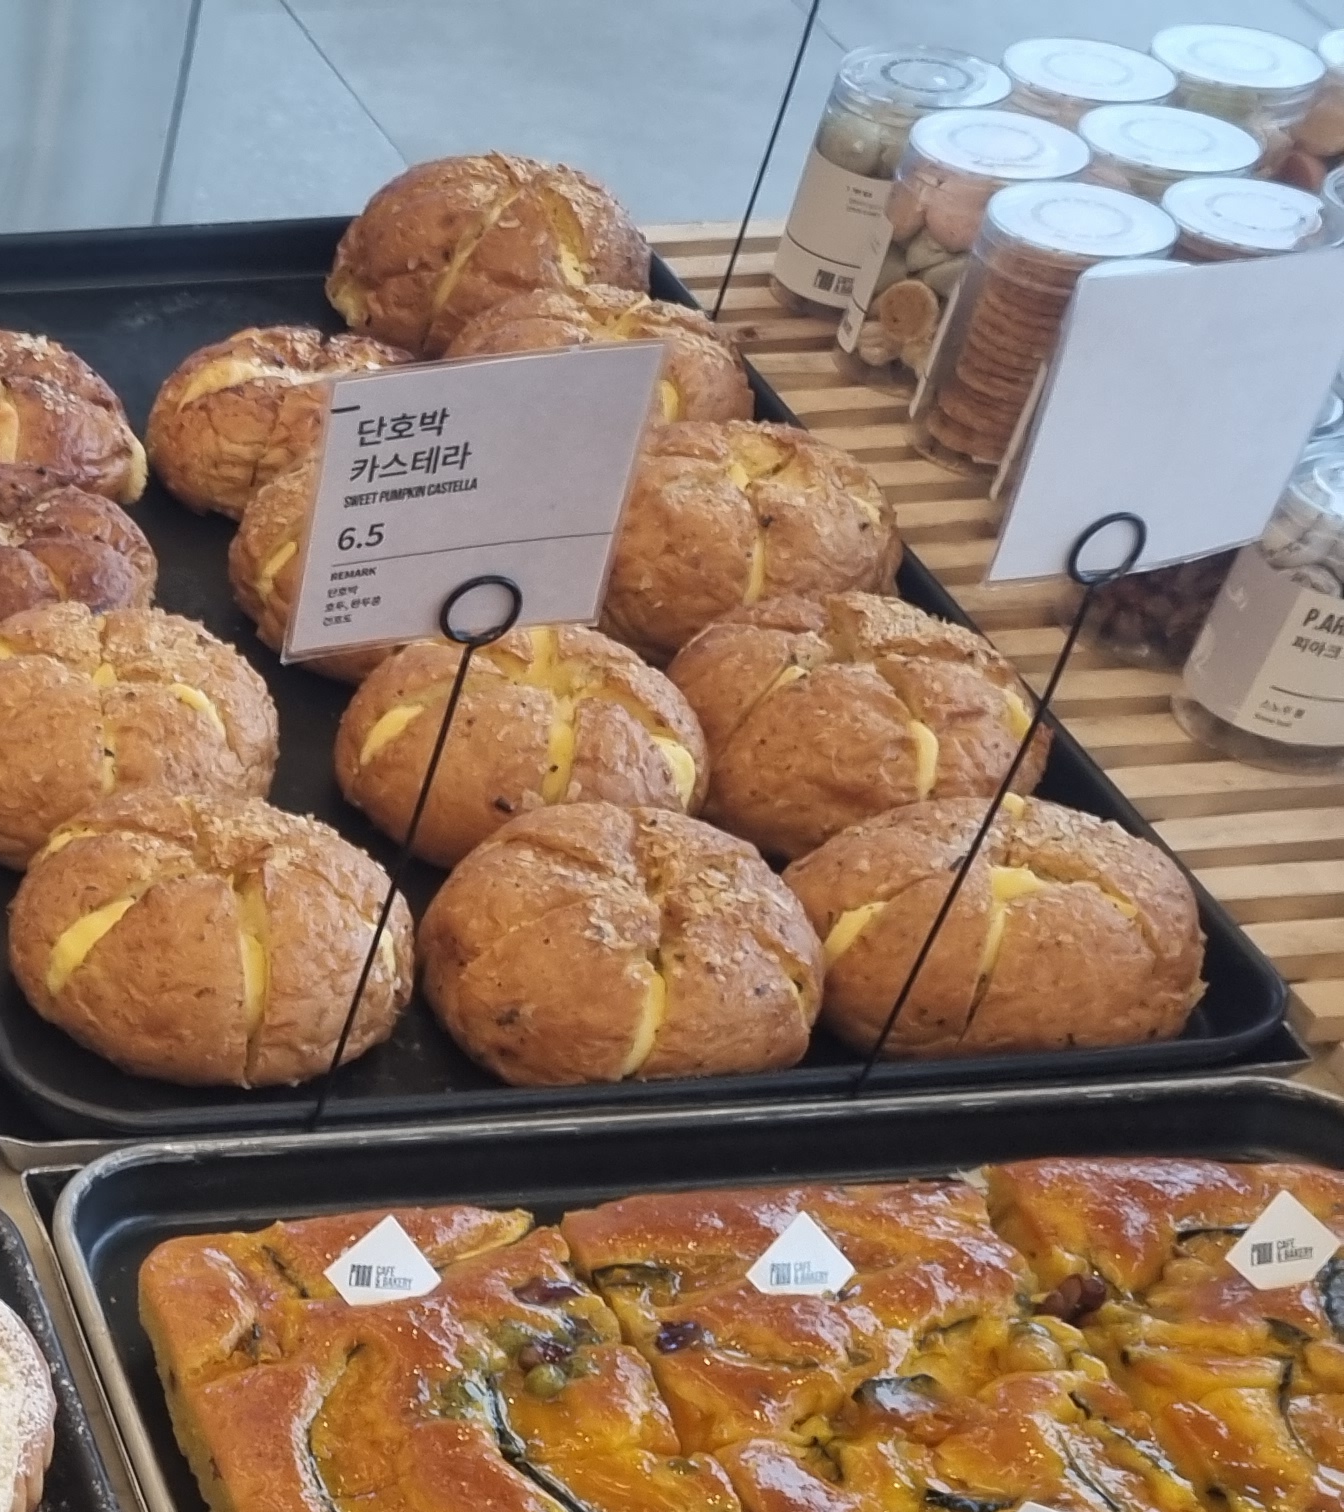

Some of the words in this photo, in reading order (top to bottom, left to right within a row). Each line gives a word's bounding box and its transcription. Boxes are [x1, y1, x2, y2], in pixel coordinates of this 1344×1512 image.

[357, 407, 451, 447] 단호박
[349, 441, 473, 483] 카스테라
[343, 491, 379, 508] SWEET
[378, 485, 427, 502] PUMPKIN
[426, 477, 478, 496] CASTELLA
[337, 522, 385, 551] 6.5
[329, 567, 377, 581] REMARK
[1292, 634, 1343, 660] 피아크
